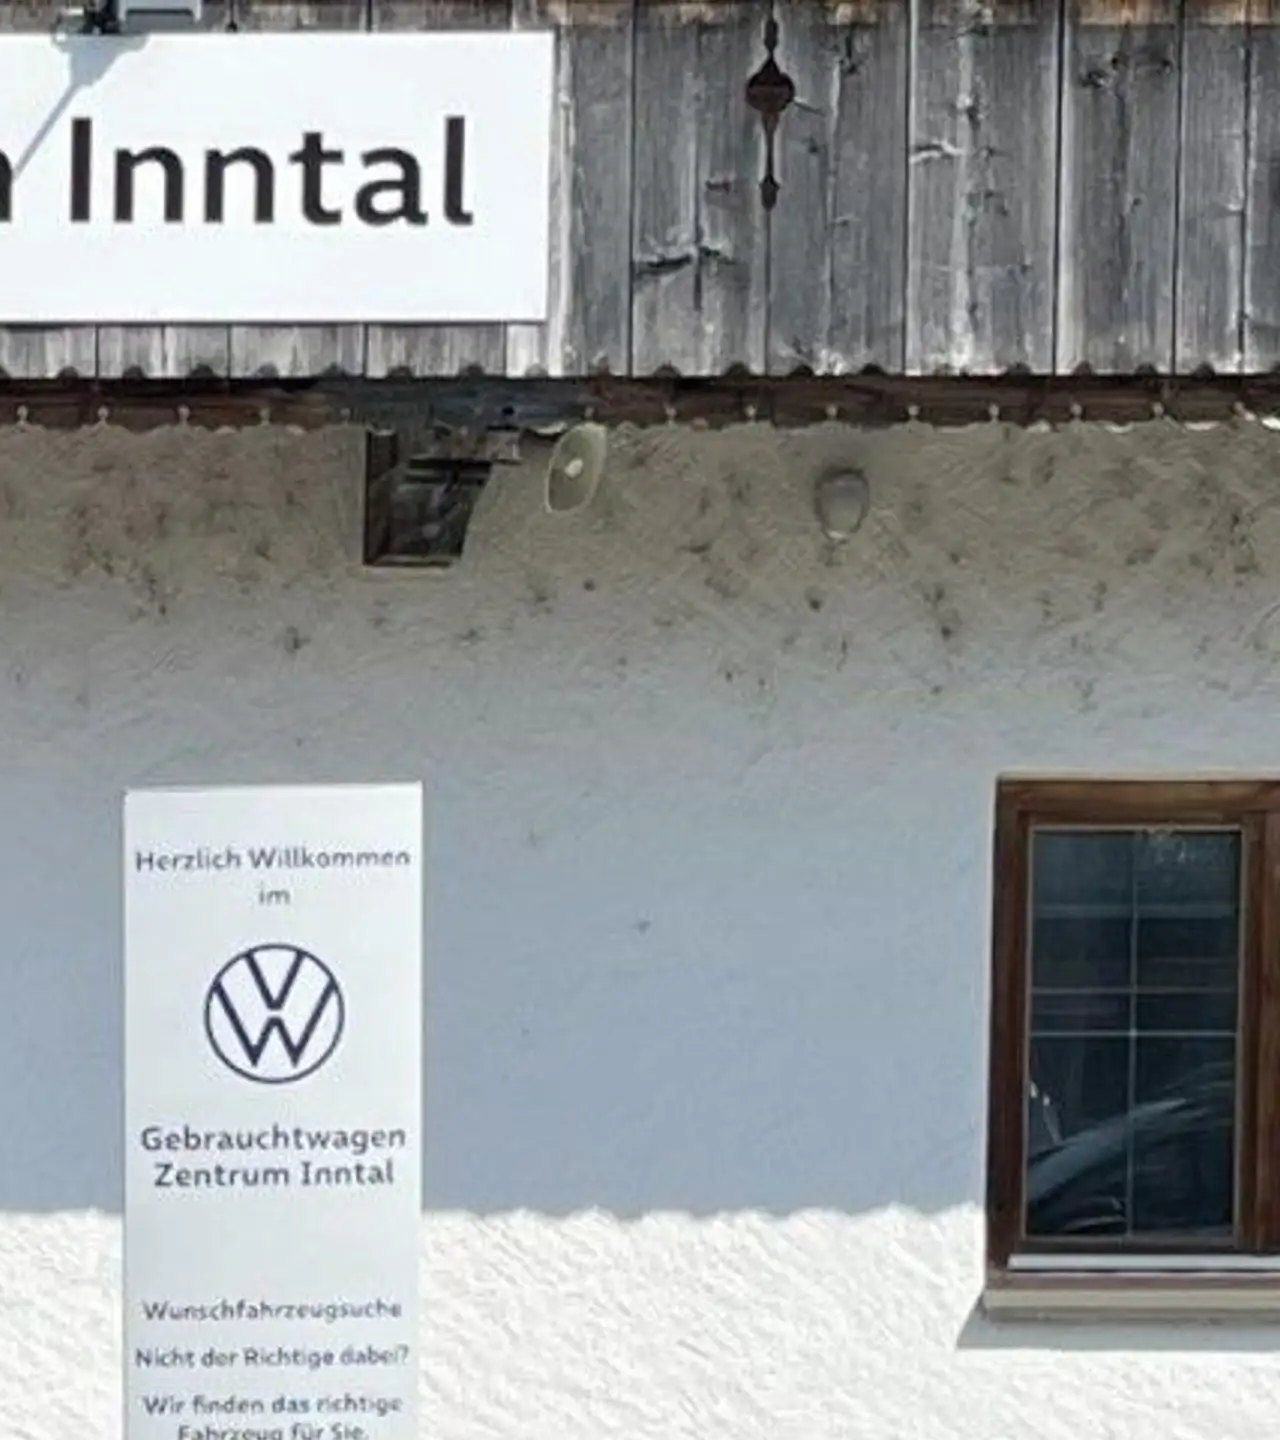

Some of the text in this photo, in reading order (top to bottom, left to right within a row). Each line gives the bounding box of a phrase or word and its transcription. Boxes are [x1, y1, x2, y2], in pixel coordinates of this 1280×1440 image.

[70, 116, 474, 227] Inntal
[135, 846, 411, 873] Herzlich Willkommen
[258, 885, 291, 905] im
[140, 1123, 406, 1155] Gebrauchtwagen
[153, 1159, 394, 1189] Zentrum Inntal
[142, 1299, 402, 1325] Wunschfahrzeugsuche
[135, 1344, 410, 1371] Nicht der Richtige dabei?
[142, 1393, 403, 1418] Wir finden das richtige
